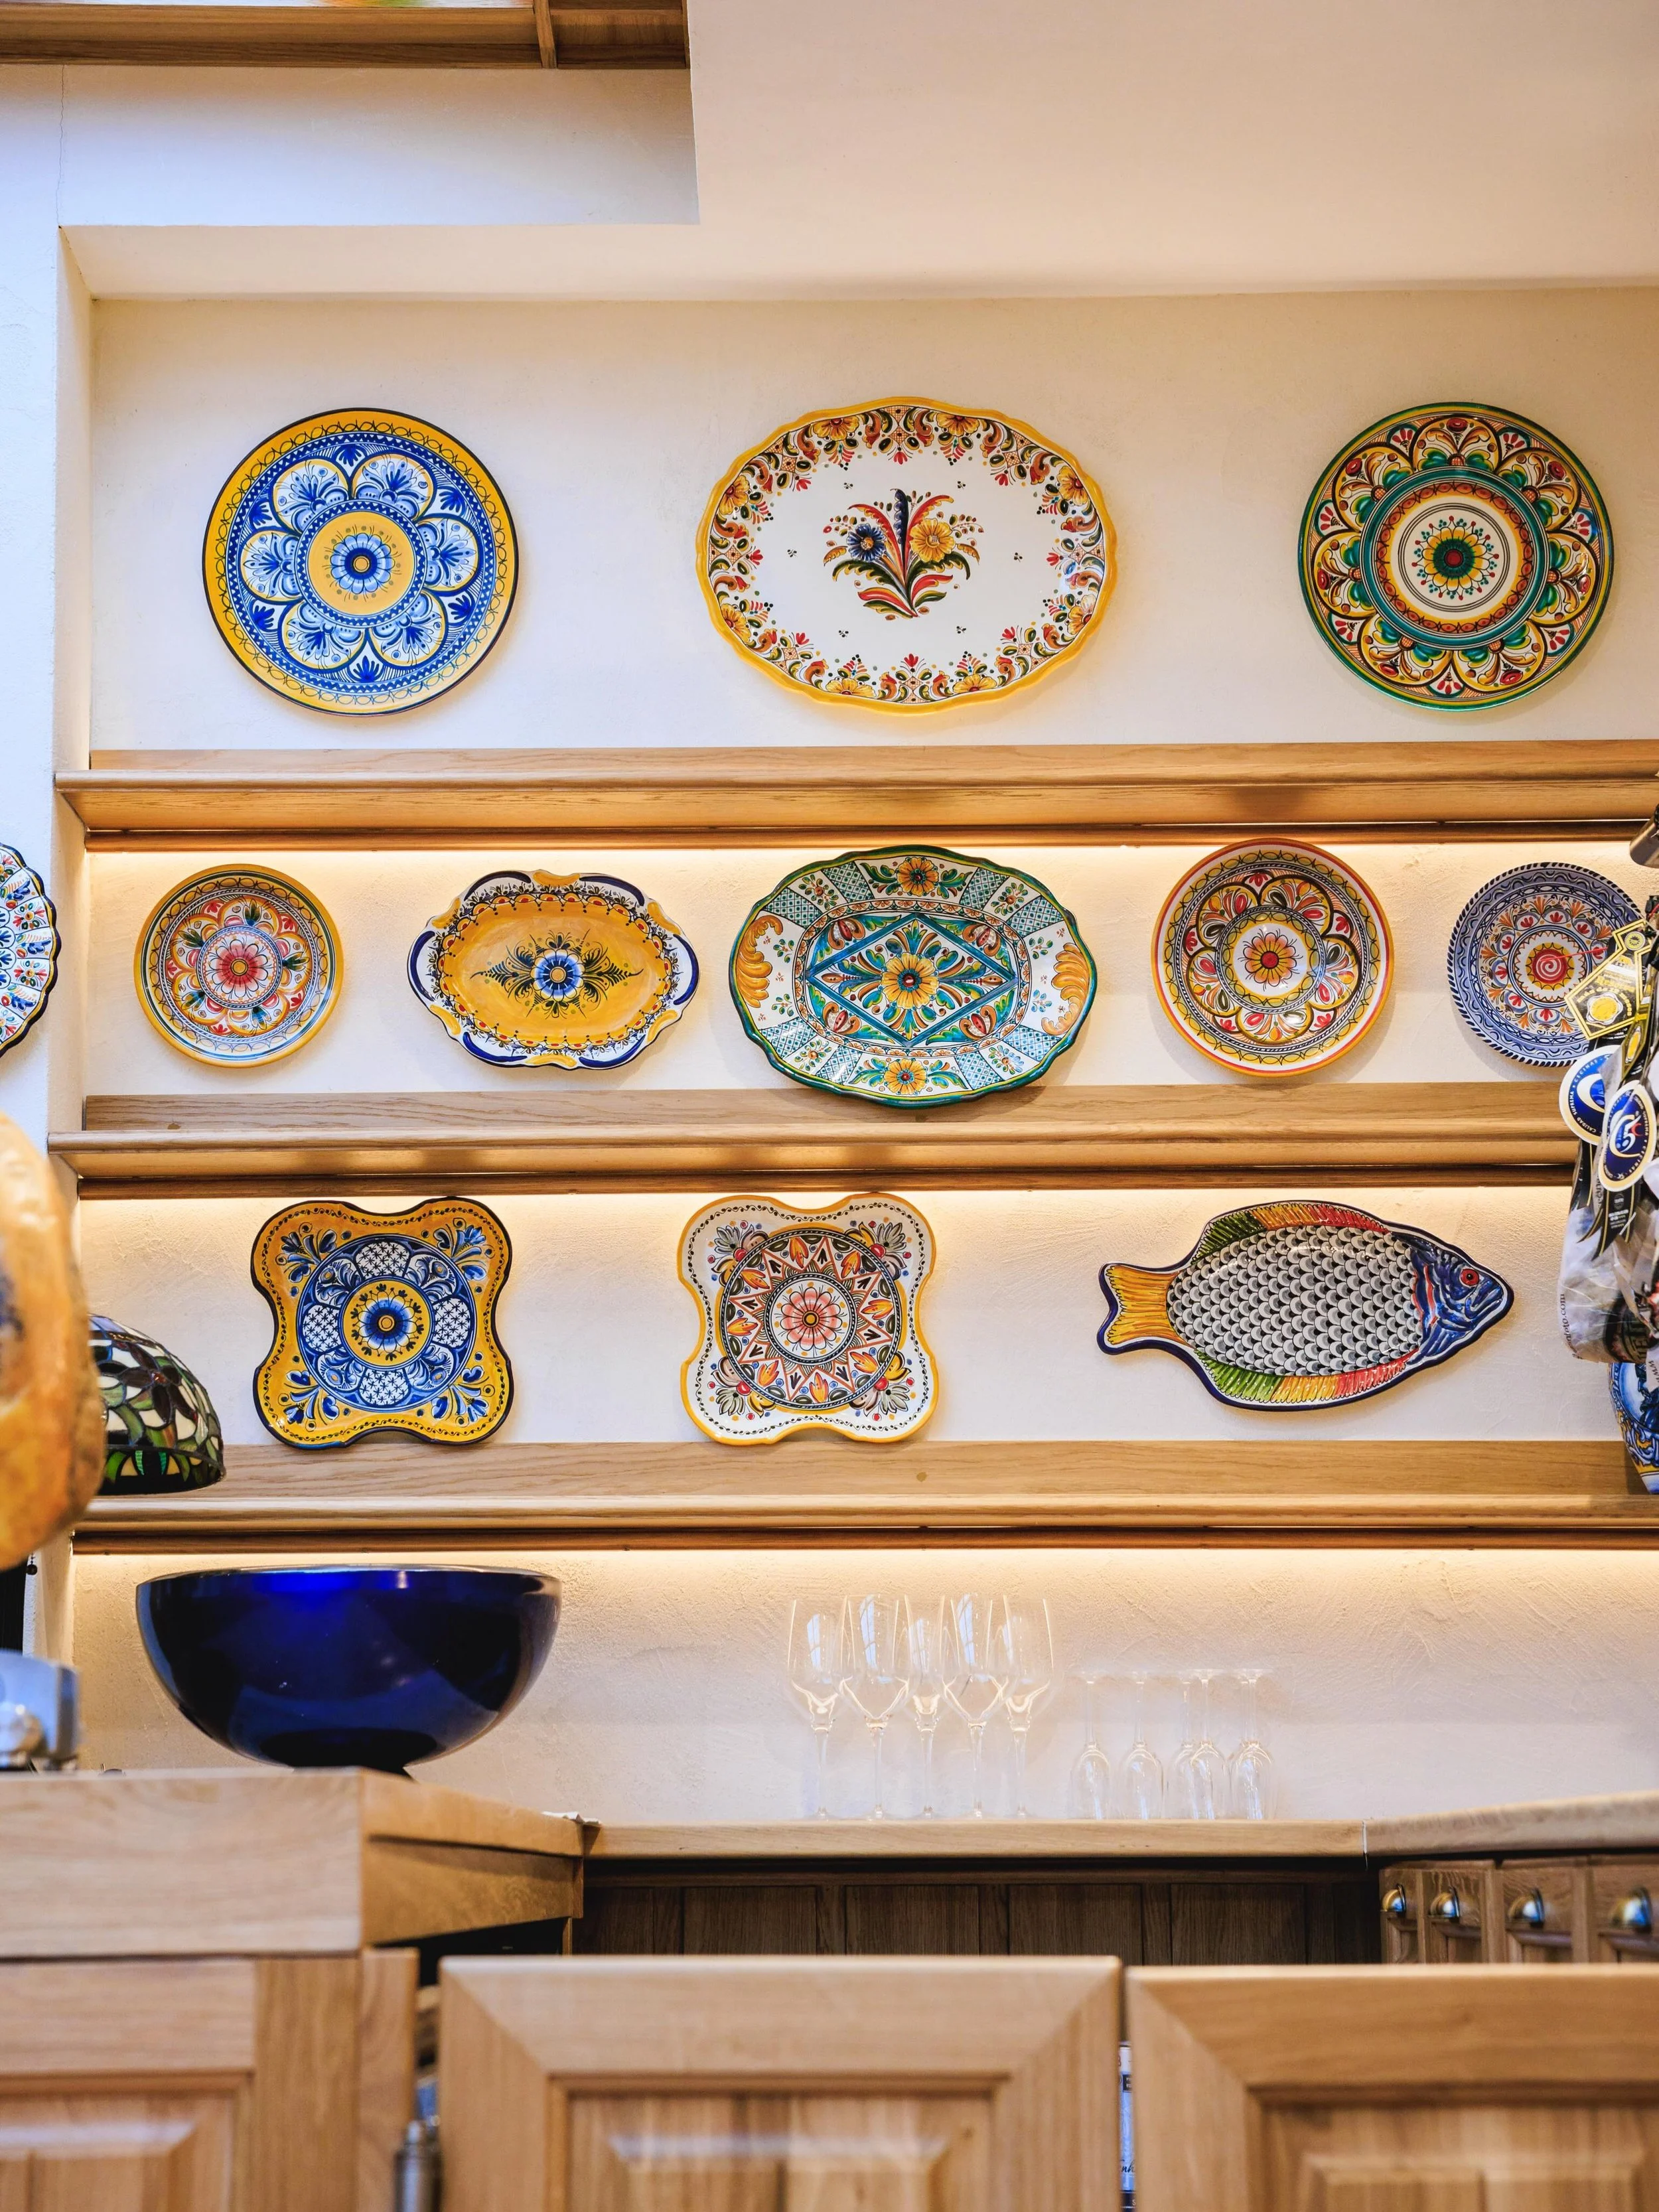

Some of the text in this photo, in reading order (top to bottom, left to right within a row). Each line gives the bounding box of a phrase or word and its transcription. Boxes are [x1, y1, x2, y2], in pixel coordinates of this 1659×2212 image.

[1569, 1059, 1598, 1134] CALIDAD SUPREMA CECINAS
